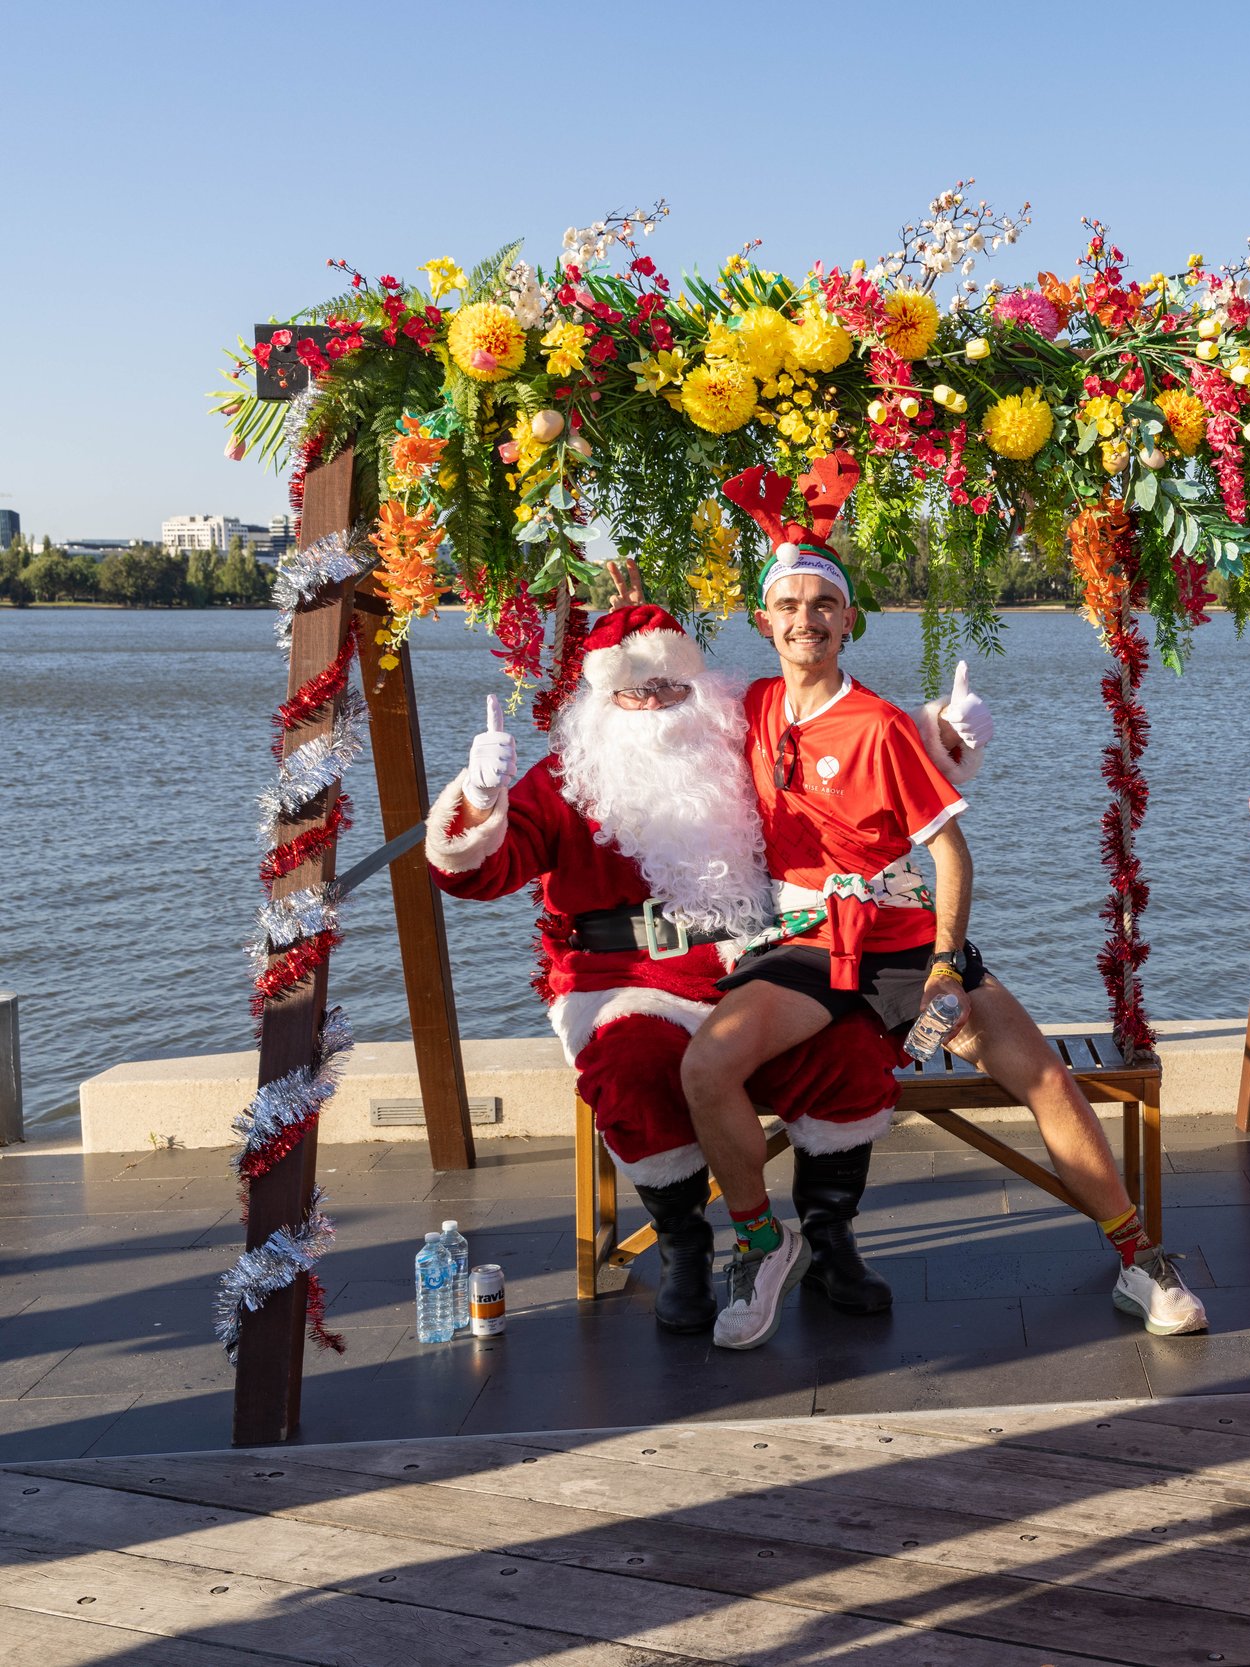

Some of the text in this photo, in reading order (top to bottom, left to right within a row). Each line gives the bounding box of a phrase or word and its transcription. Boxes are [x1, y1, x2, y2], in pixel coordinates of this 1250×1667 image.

[791, 556, 842, 580] Santa Run
[821, 787, 845, 795] ABOVE
